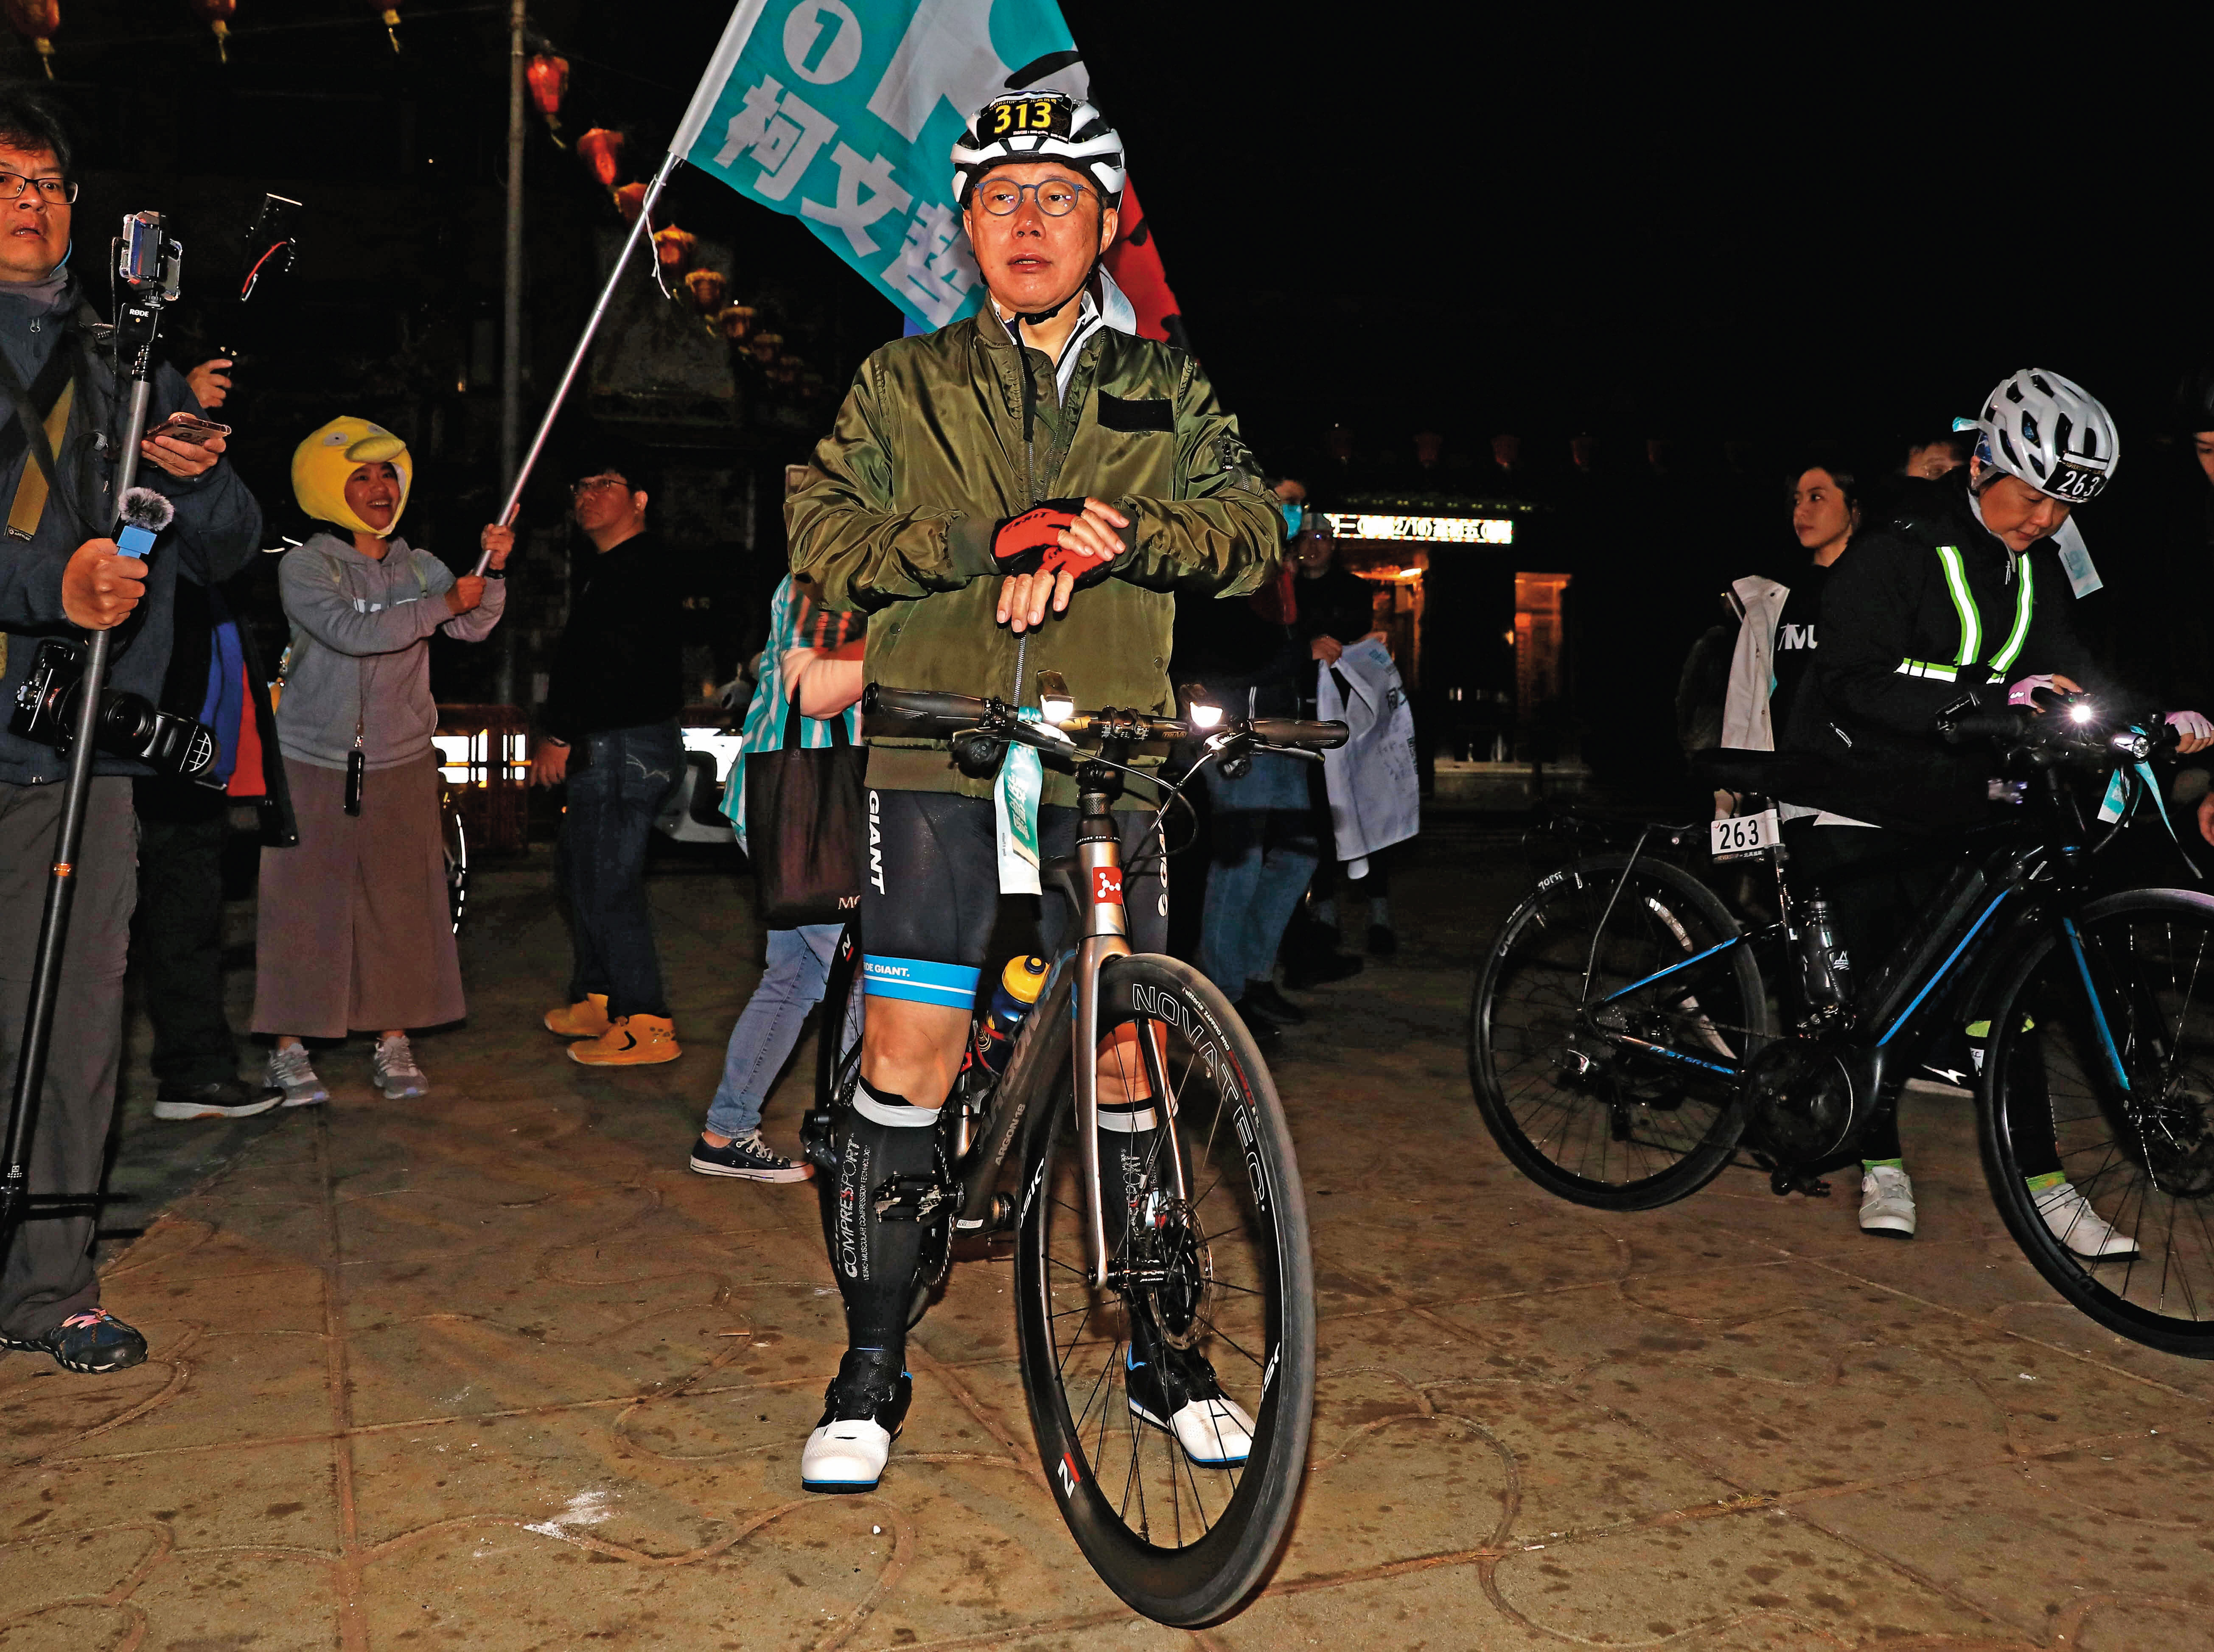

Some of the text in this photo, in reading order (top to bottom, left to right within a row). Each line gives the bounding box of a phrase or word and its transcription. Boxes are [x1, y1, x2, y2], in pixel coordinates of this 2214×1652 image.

[993, 102, 1051, 134] 313
[713, 73, 984, 329] 柯文哲
[129, 308, 149, 317] RØDE
[2057, 470, 2100, 497] 263
[869, 790, 886, 896] GIANT
[1720, 819, 1759, 850] 263
[874, 963, 910, 977] GIANT.
[1132, 983, 1265, 1205] NOVATEC
[995, 1118, 1019, 1166] ARGON
